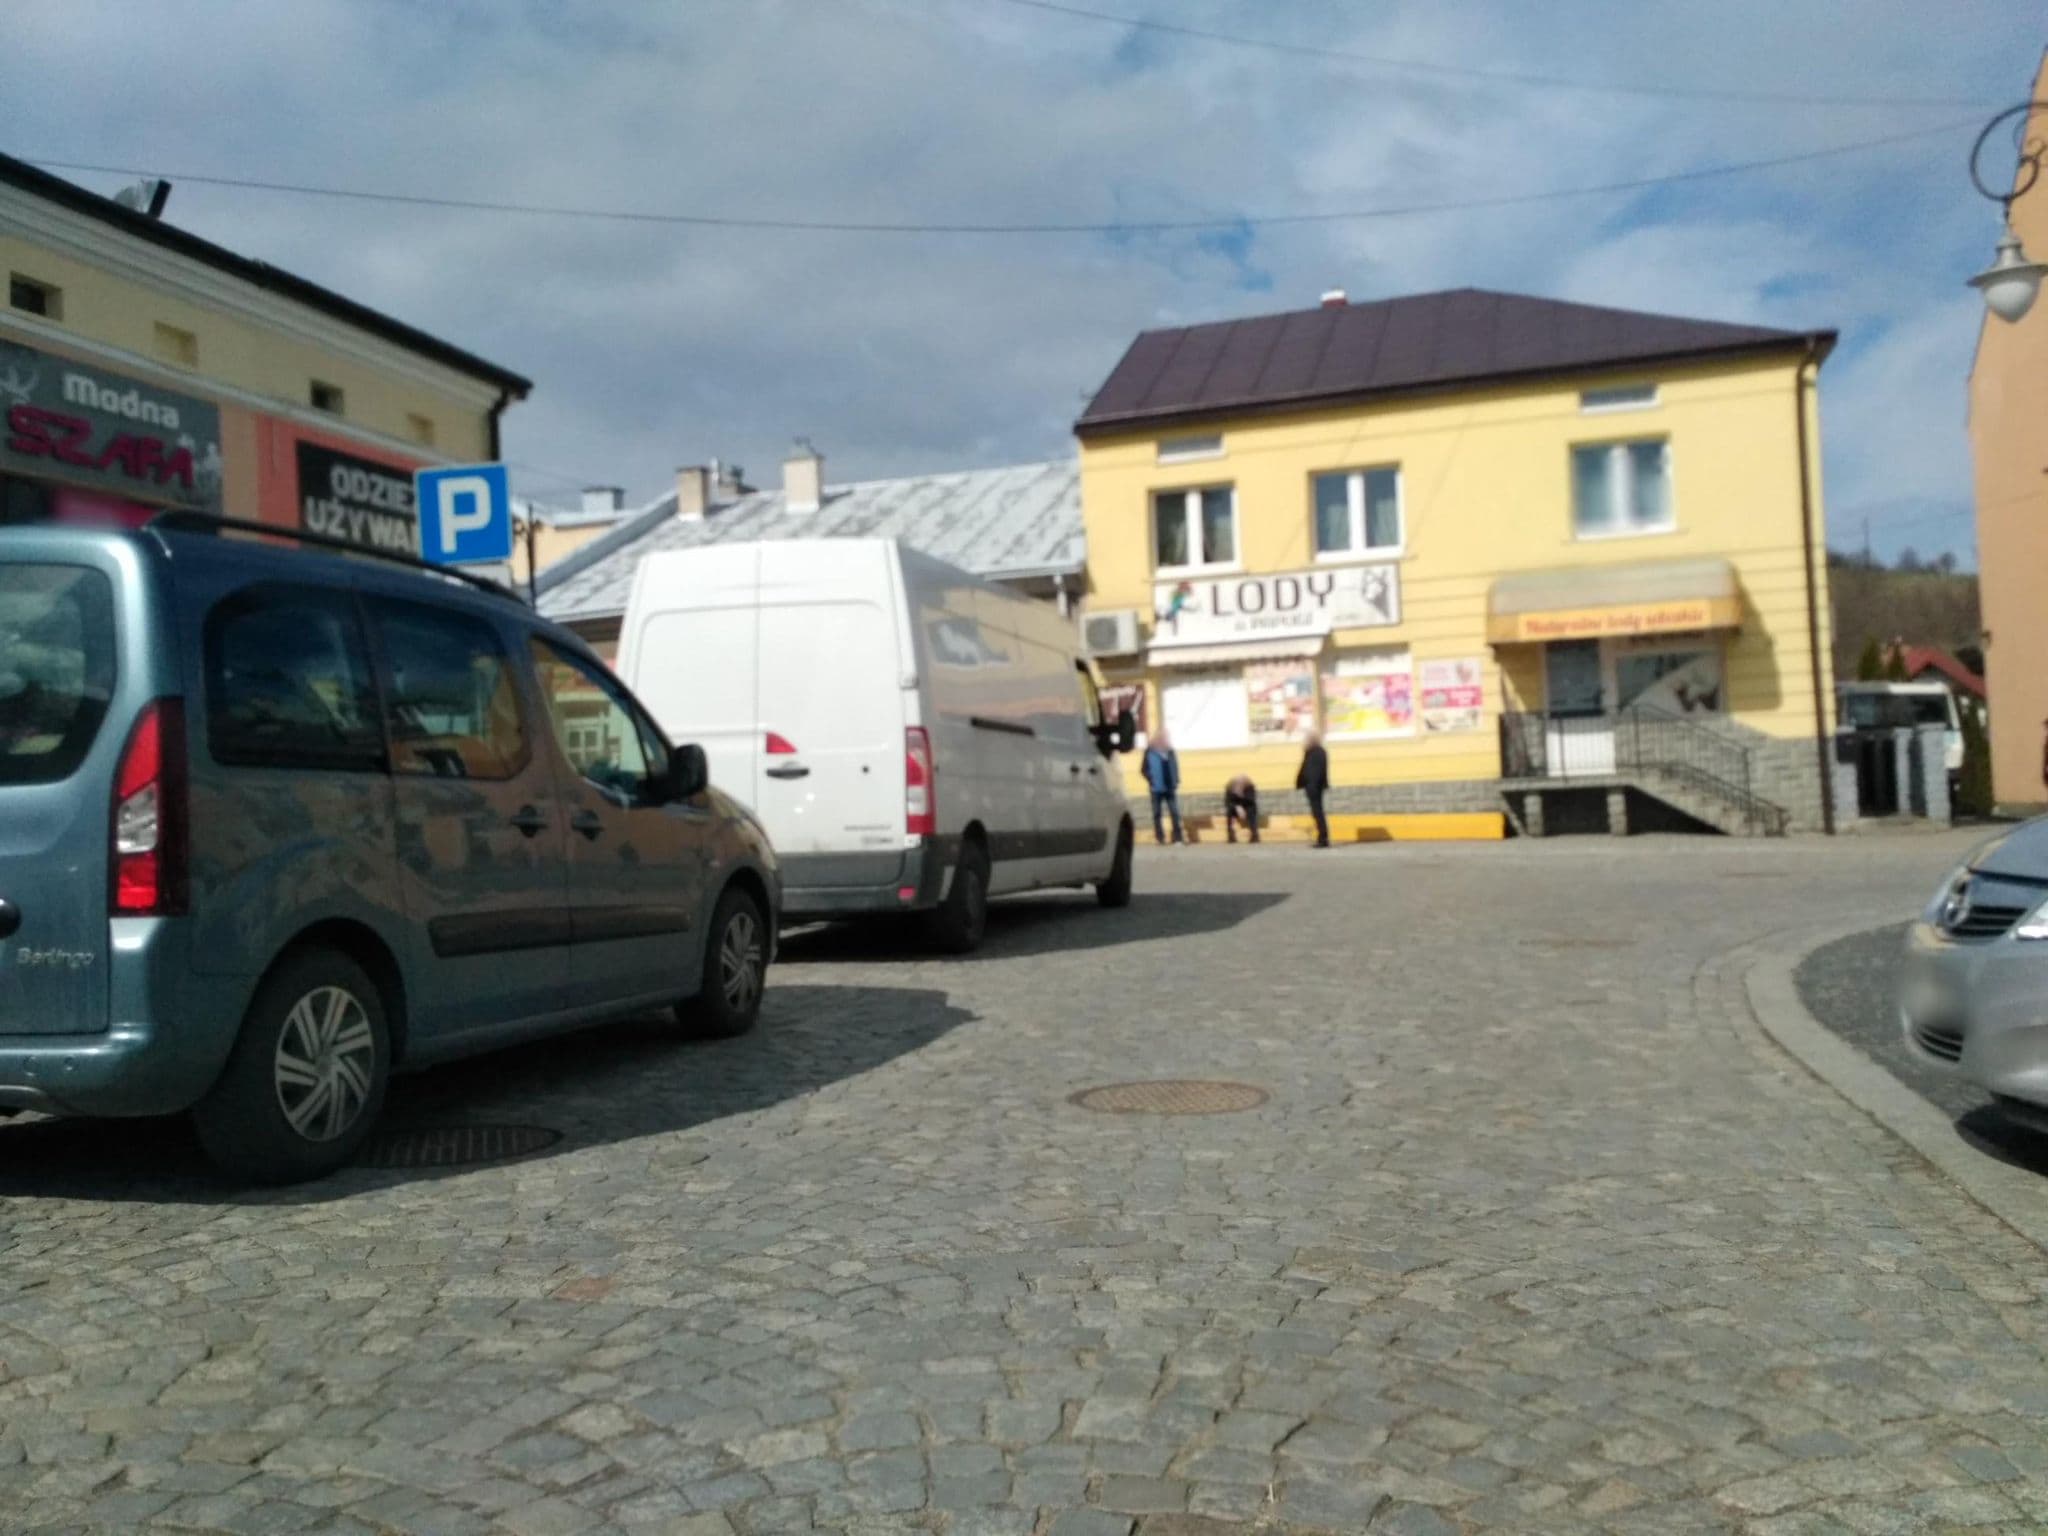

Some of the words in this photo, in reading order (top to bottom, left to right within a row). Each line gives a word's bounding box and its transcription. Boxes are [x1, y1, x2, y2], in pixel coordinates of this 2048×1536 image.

[437, 476, 491, 553] P
[1211, 573, 1334, 616] LODY
[16, 947, 95, 969] Berlingo
